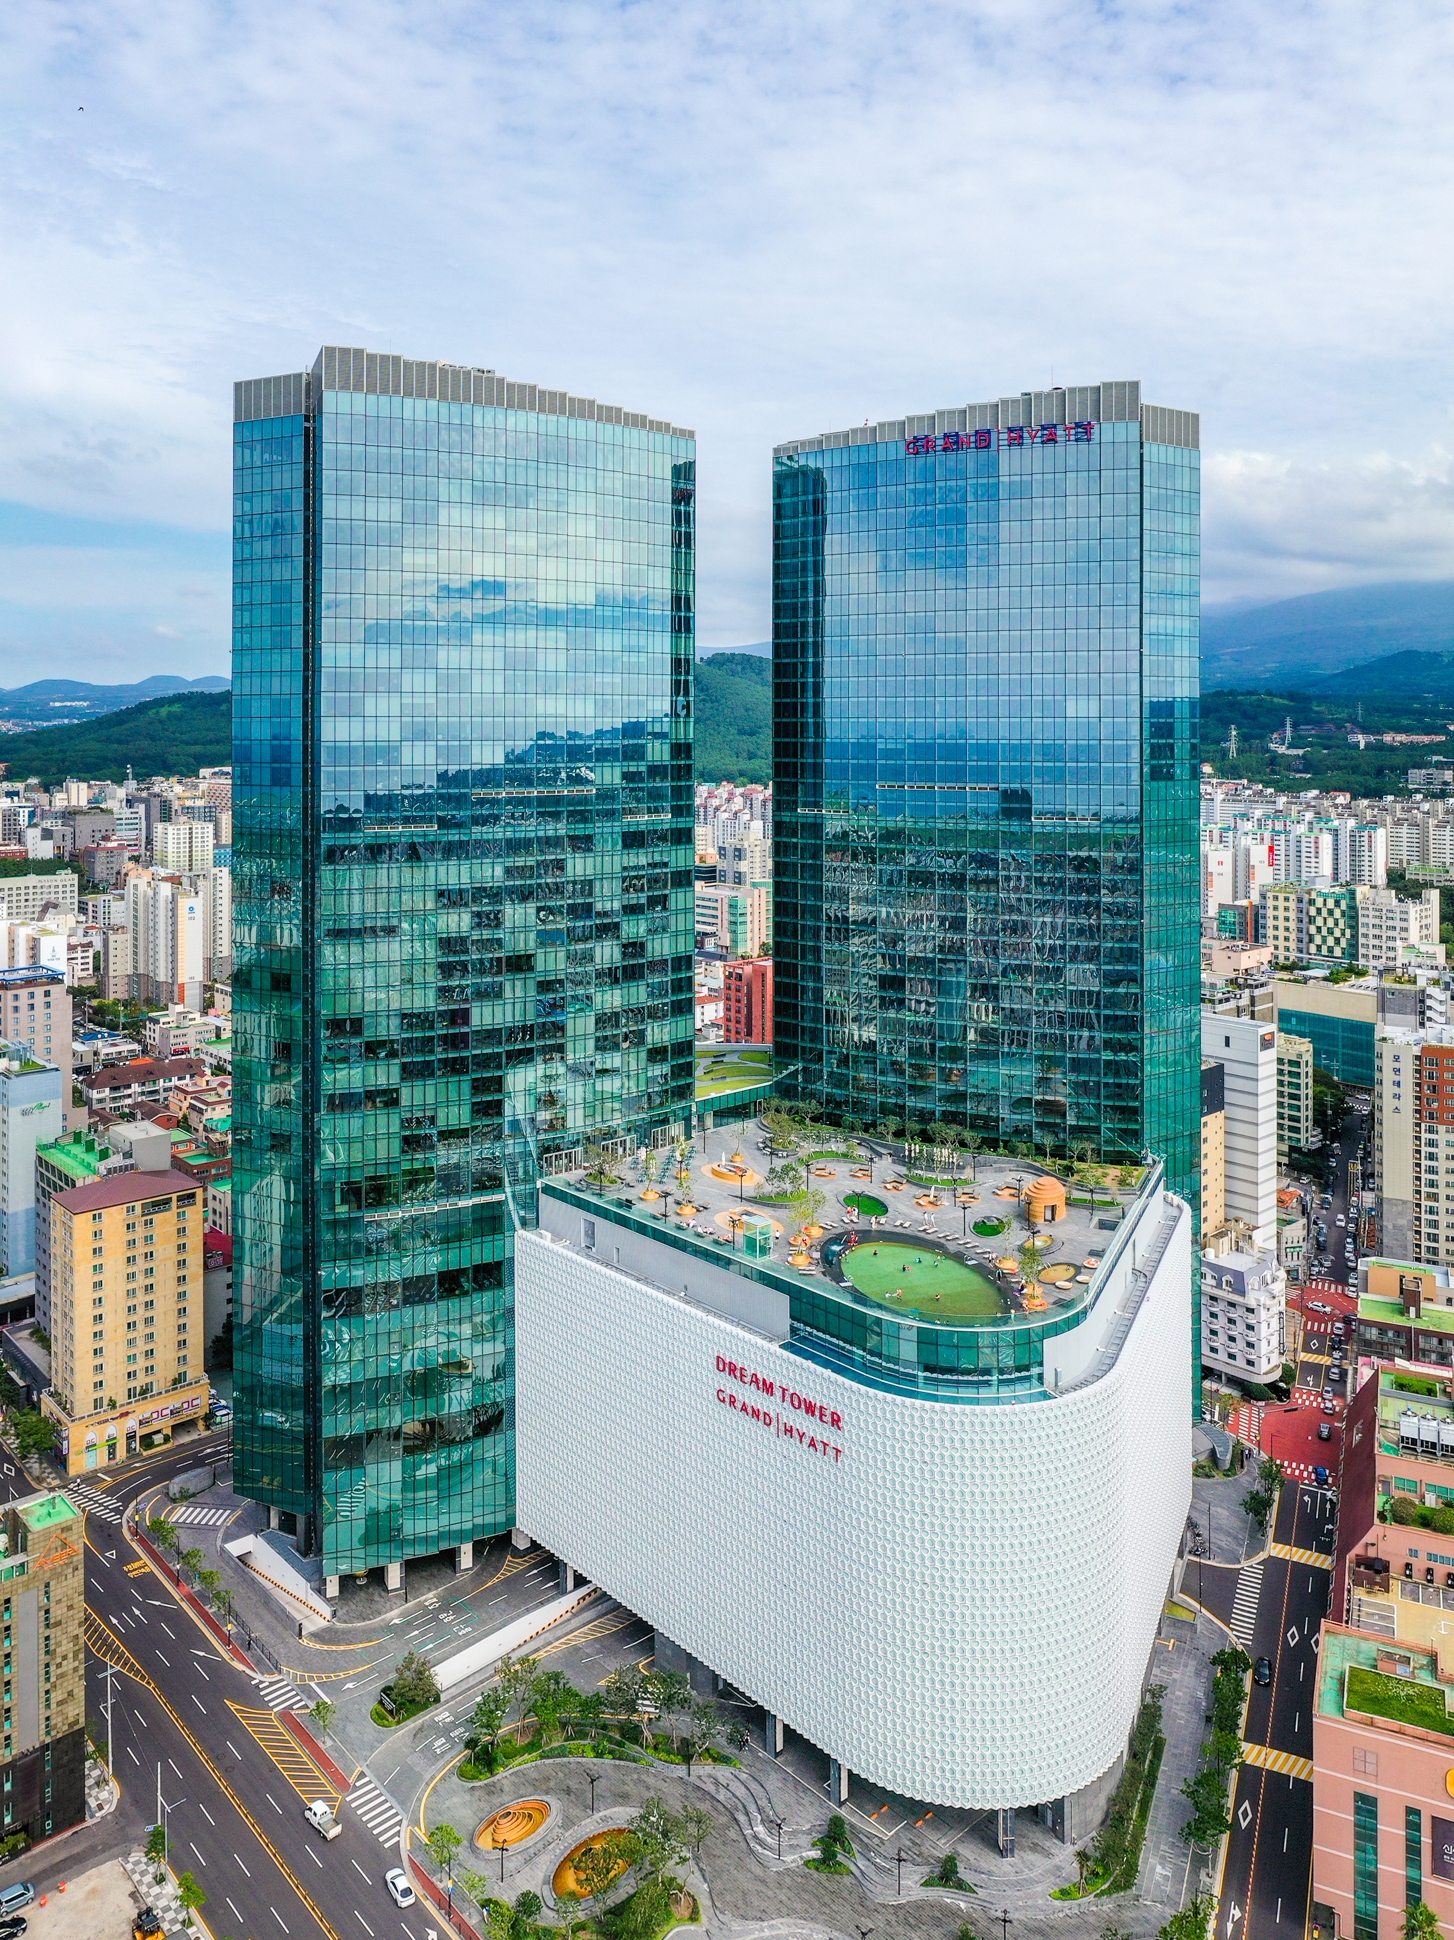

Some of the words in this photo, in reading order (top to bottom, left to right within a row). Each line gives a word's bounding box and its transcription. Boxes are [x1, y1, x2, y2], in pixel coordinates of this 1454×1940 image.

[905, 431, 991, 455] GRAND
[1007, 423, 1095, 446] HYATT
[716, 1355, 774, 1397] DREAM
[779, 1385, 843, 1431] TOWER
[716, 1388, 773, 1427] GRAND
[784, 1422, 843, 1463] HYATT
[1442, 1843, 1454, 1855] 신
